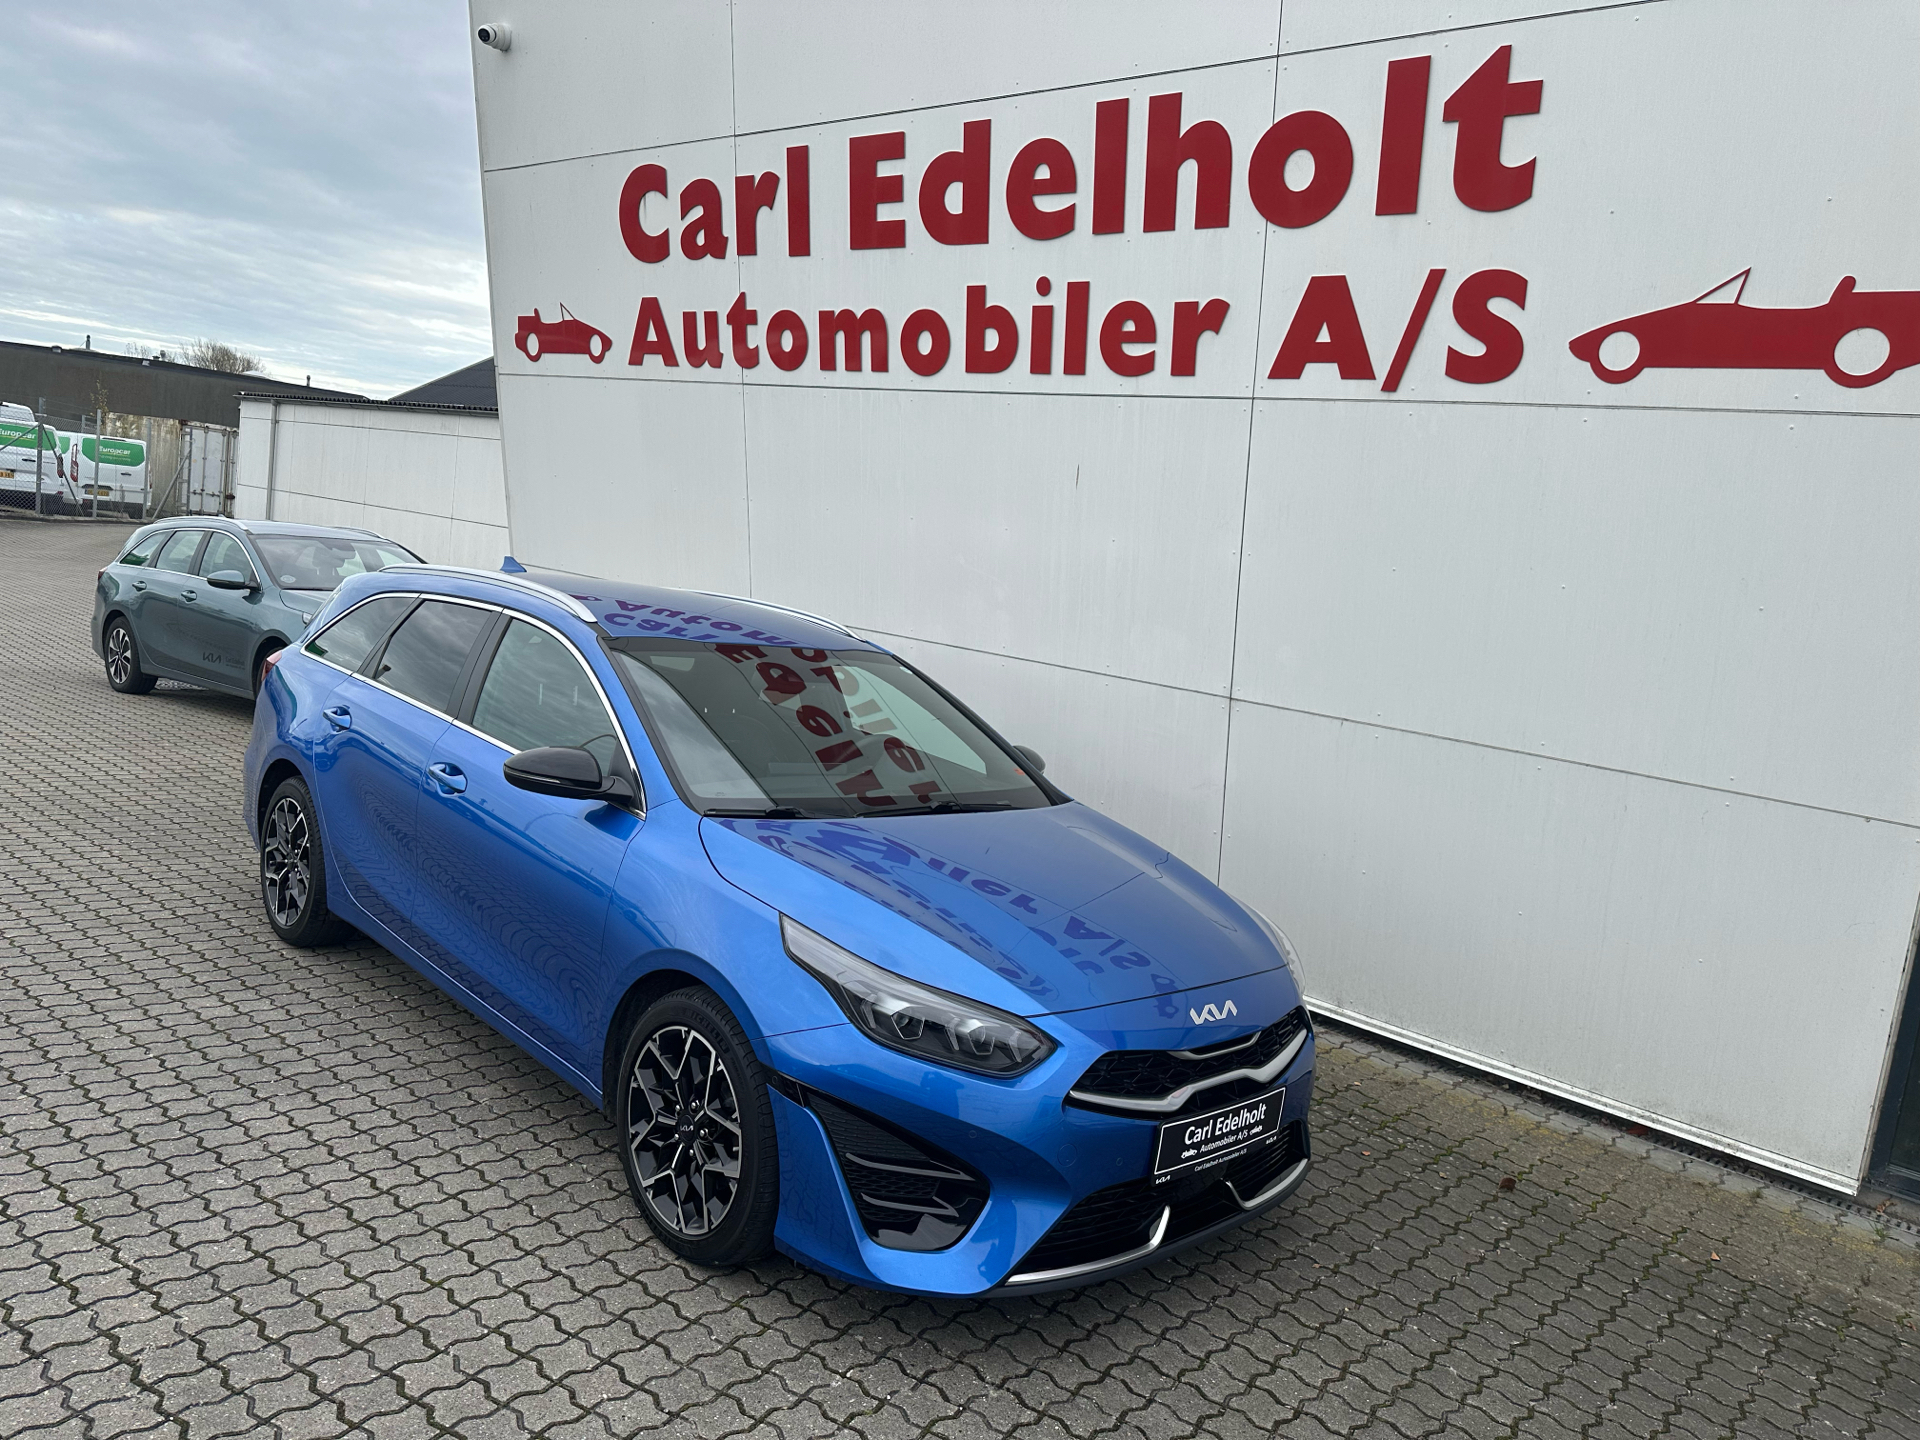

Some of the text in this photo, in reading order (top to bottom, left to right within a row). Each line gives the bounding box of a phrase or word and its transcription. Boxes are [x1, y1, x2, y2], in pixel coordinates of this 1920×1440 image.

[619, 46, 1543, 263] Carl Edelholt
[628, 268, 1527, 392] Automobiler A/S
[202, 651, 222, 664] KIA
[1189, 999, 1238, 1025] KIA
[684, 1010, 731, 1054] MICHELIN
[1184, 1102, 1267, 1145] Carl Edelholt
[1199, 1129, 1248, 1153] Automobiler A/S
[1265, 1135, 1277, 1145] KIA
[1155, 1175, 1171, 1185] KIA
